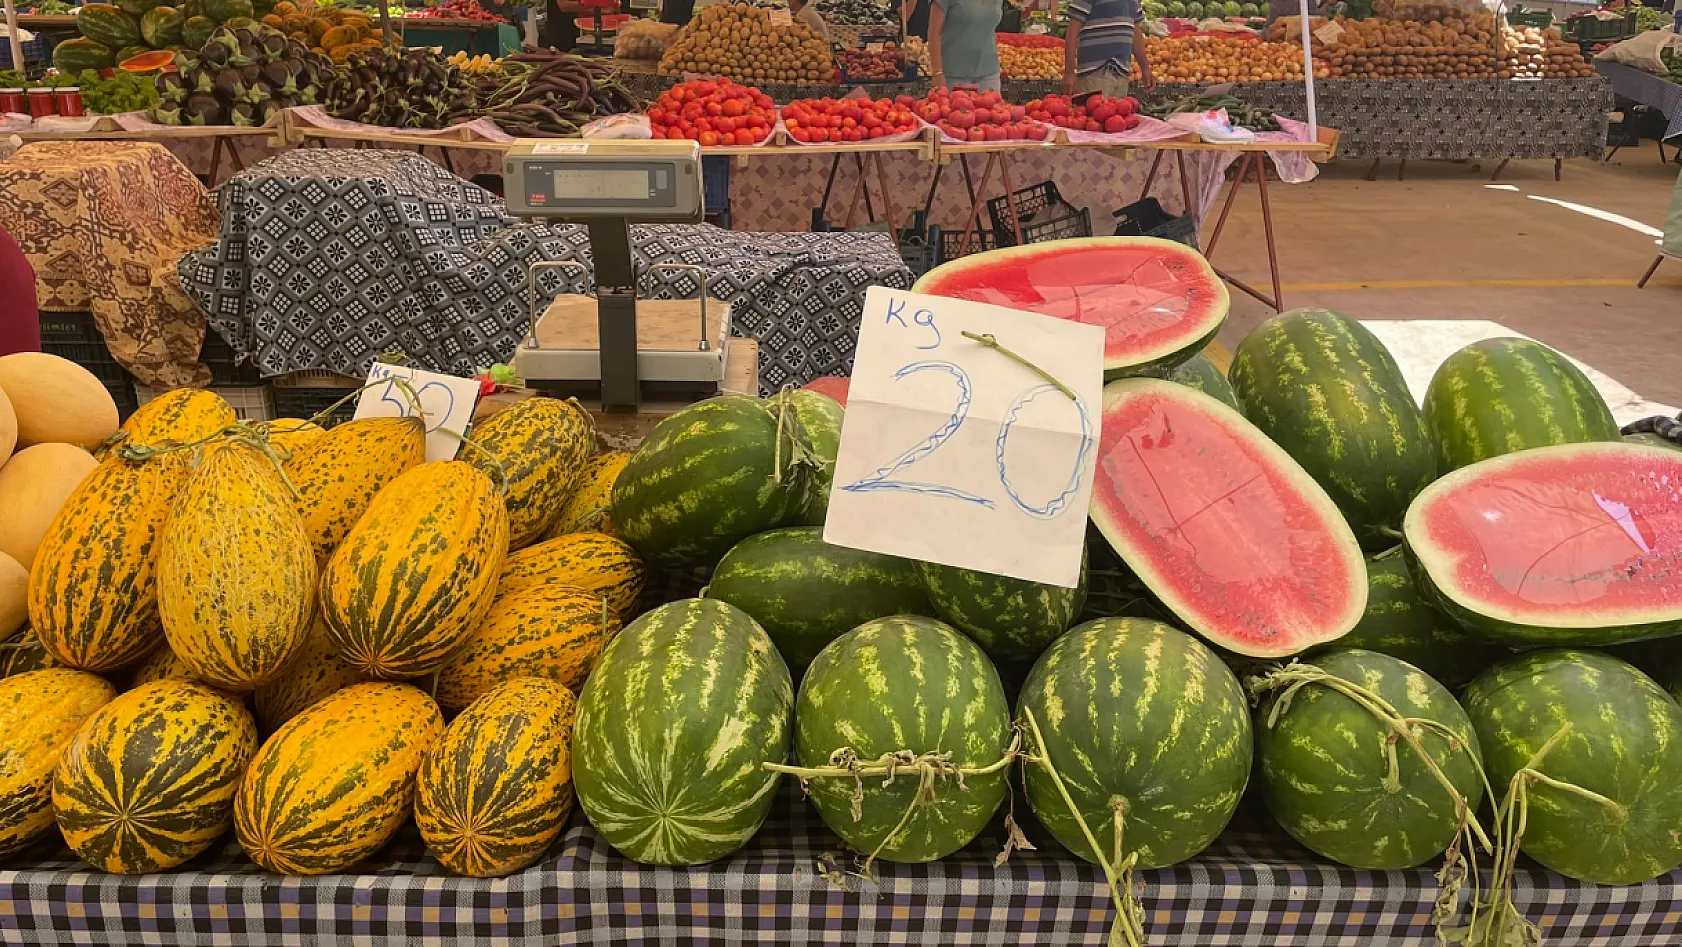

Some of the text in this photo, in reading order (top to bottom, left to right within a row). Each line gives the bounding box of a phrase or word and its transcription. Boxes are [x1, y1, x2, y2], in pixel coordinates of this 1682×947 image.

[885, 297, 941, 350] Kg
[381, 373, 454, 434] 50
[837, 360, 1094, 520] 20
